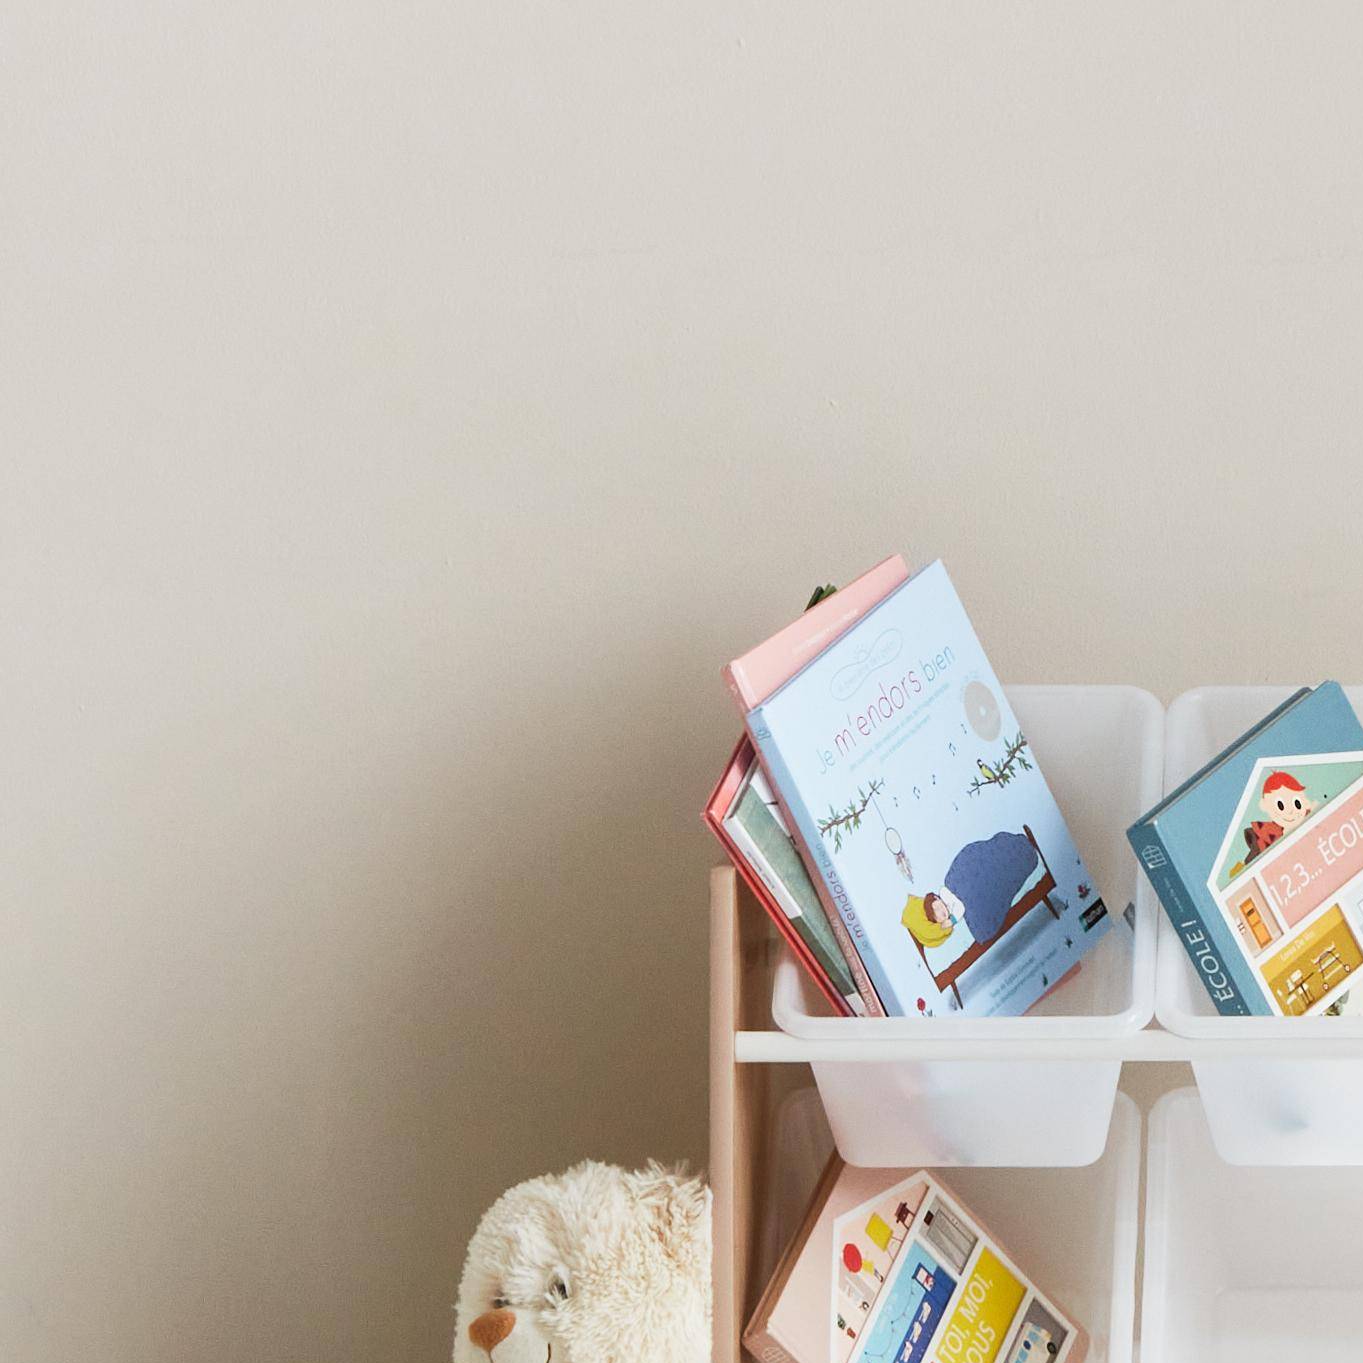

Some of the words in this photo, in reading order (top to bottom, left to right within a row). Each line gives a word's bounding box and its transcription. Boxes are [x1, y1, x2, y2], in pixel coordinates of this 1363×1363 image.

[816, 742, 835, 776] Je
[834, 669, 922, 755] m'endors
[921, 645, 956, 683] bien
[828, 871, 864, 938] m'endors
[939, 1323, 970, 1363] TOI,
[959, 1273, 994, 1323] MOI,
